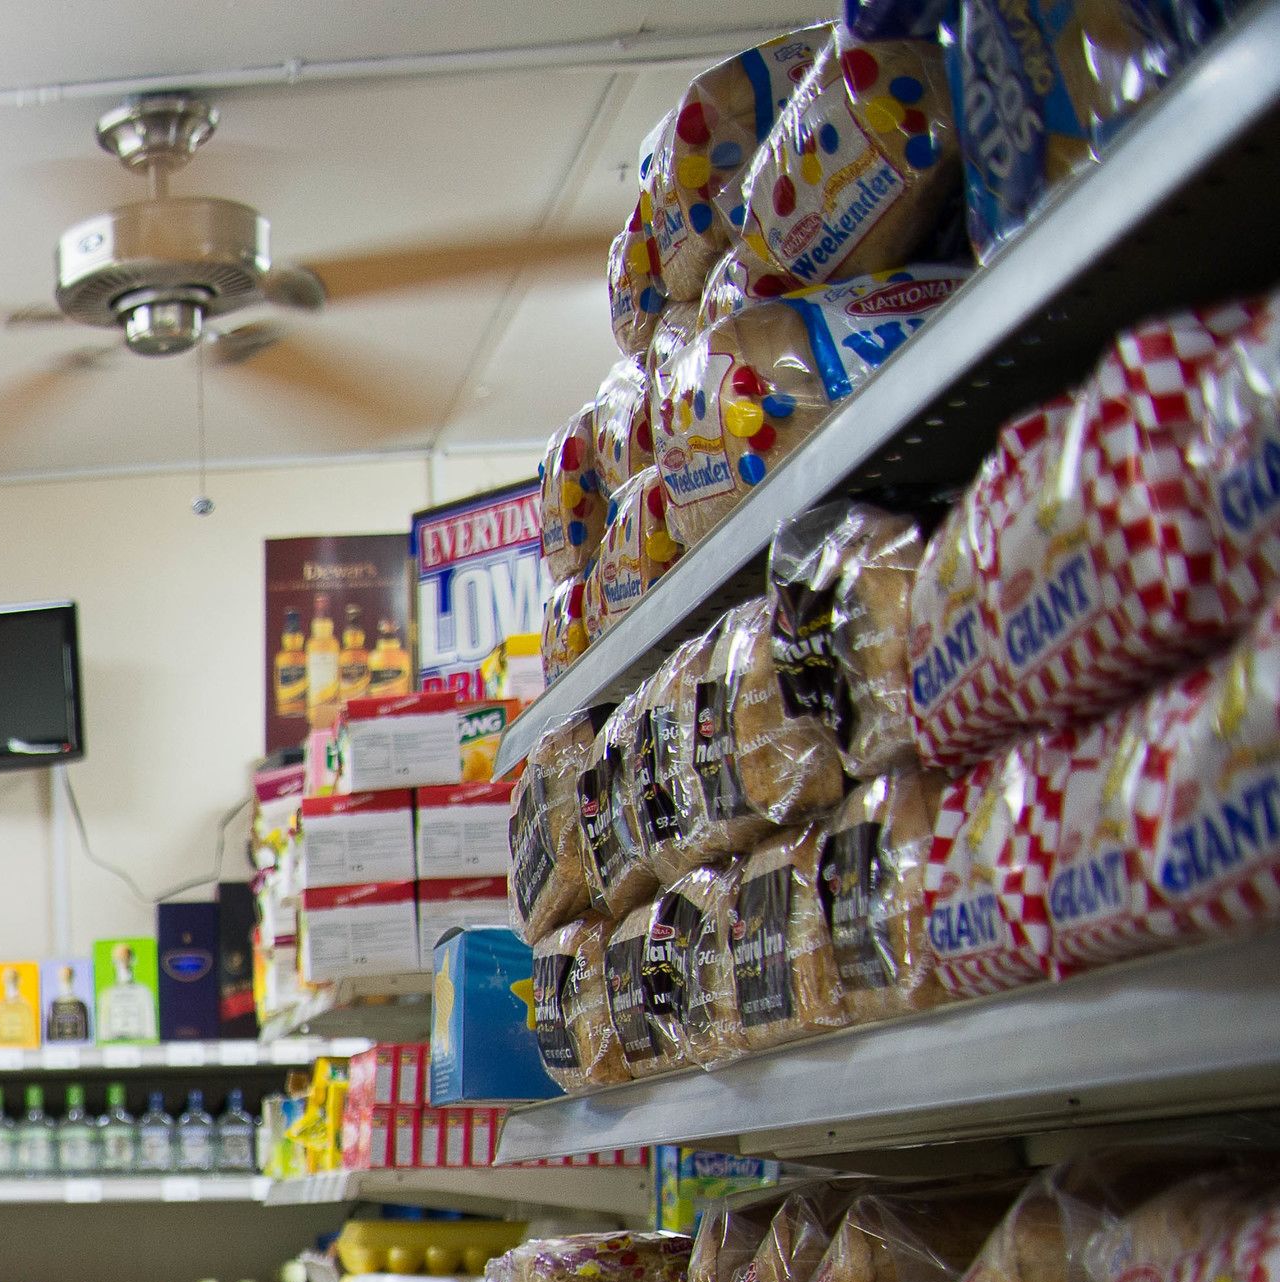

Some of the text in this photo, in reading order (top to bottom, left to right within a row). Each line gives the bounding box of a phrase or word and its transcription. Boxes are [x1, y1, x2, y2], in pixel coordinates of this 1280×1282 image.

[790, 164, 896, 281] Weekender
[664, 455, 731, 496] Weekender
[1007, 553, 1091, 667] GIANT
[912, 610, 980, 707] GIANT
[459, 708, 504, 740] ANG
[1160, 774, 1280, 893] GIANT
[929, 893, 1000, 959] GIANT
[1051, 850, 1126, 922] GIANT
